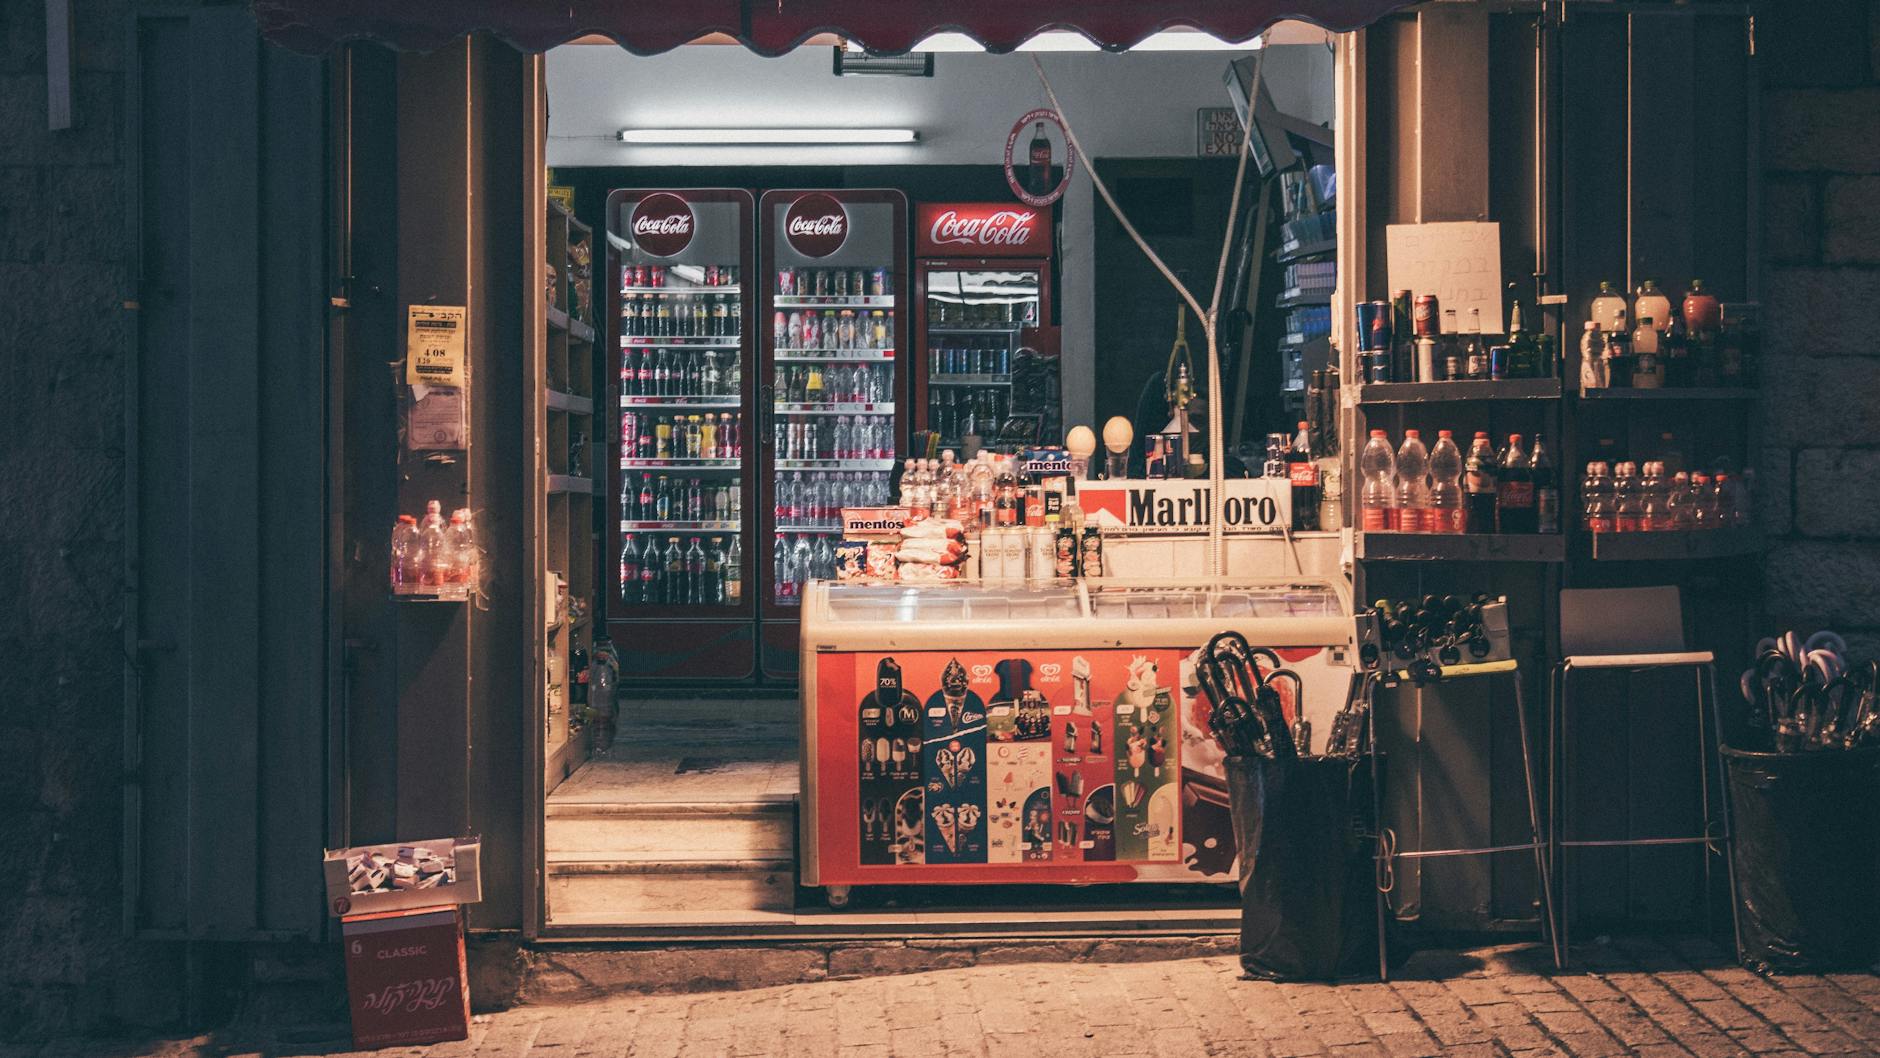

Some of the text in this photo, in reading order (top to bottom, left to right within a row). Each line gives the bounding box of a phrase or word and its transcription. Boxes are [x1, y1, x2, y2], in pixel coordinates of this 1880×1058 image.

[1214, 132, 1235, 144] NO
[1205, 143, 1243, 155] EXIT
[1029, 460, 1071, 471] mento
[1128, 488, 1276, 526] Marloro
[849, 519, 906, 530] mentos
[880, 678, 897, 686] 70%
[351, 940, 362, 954] 6
[377, 945, 427, 960] CLASSIC
